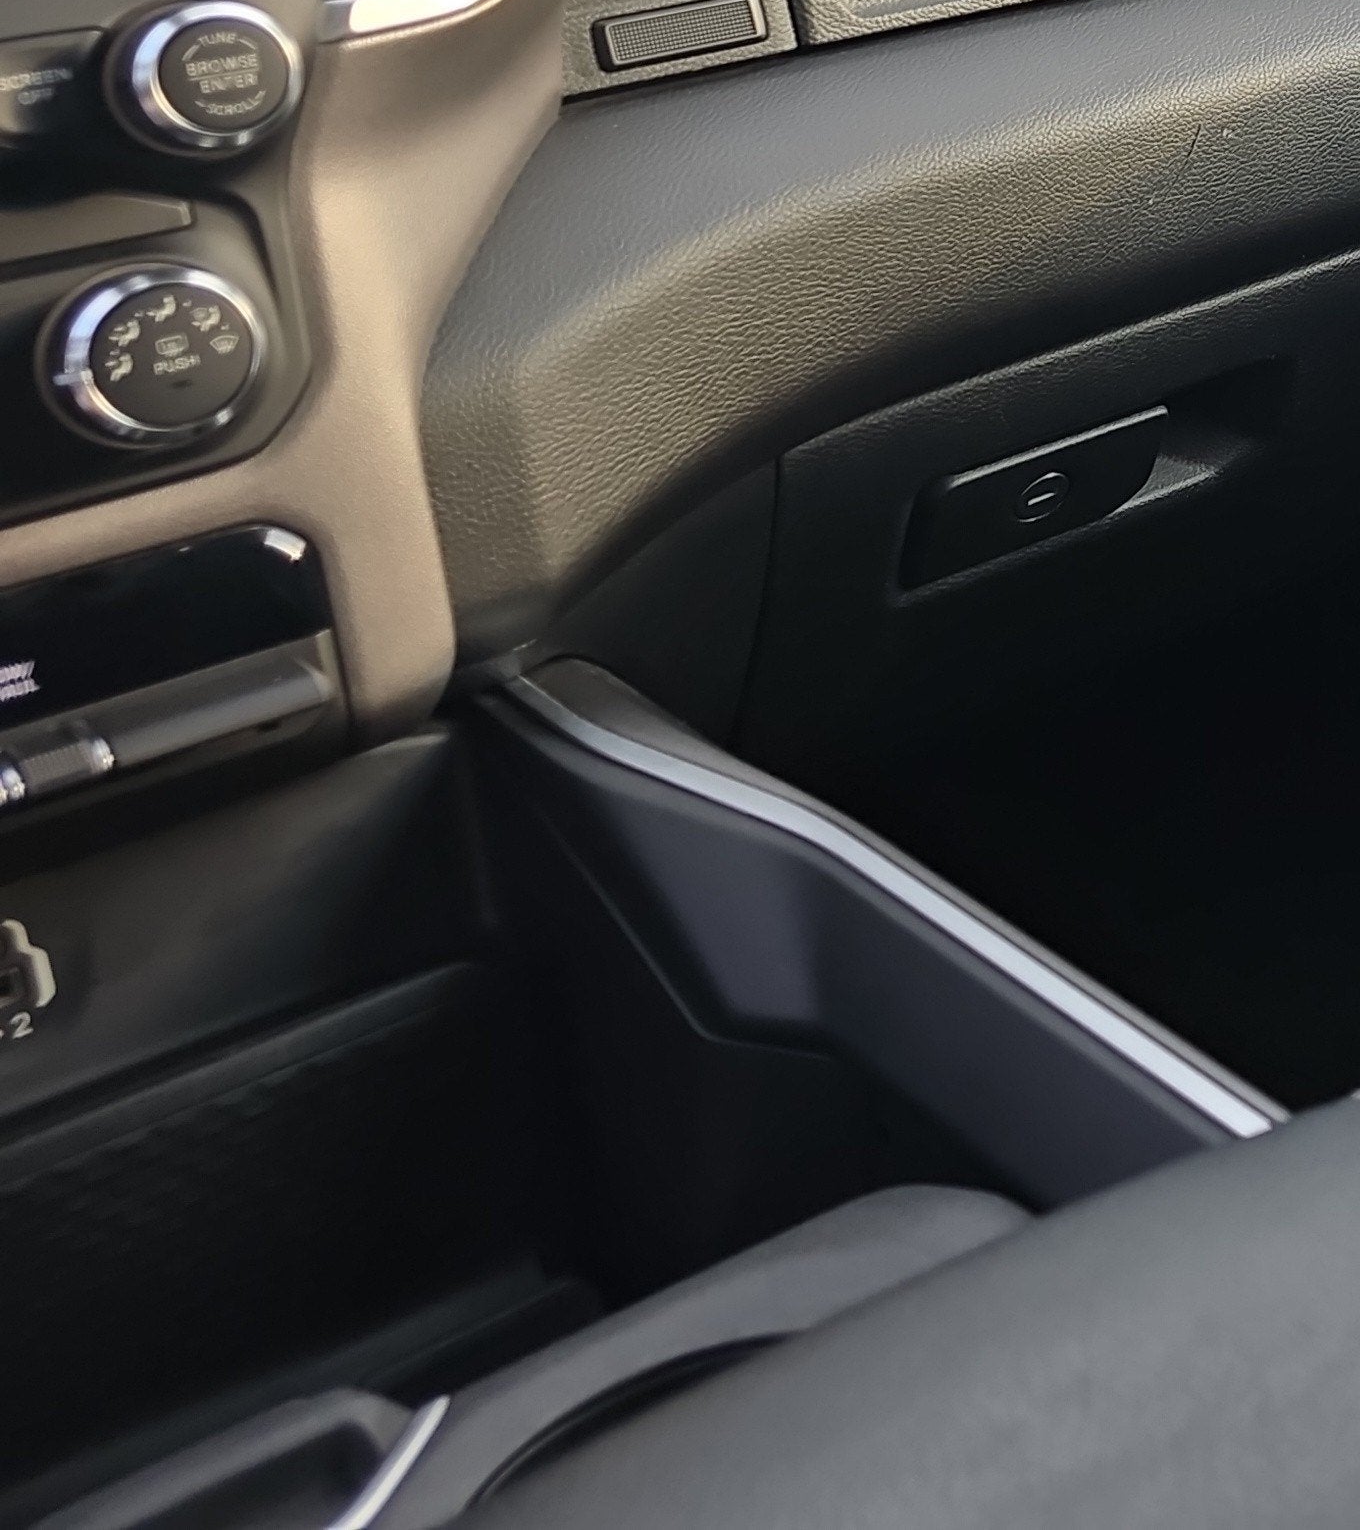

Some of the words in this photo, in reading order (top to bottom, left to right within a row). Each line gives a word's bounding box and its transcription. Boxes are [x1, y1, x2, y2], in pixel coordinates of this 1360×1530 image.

[198, 31, 237, 45] TUNE
[185, 53, 260, 77] BROWSE
[199, 74, 259, 94] ENTER
[205, 99, 259, 116] SCROLL
[153, 354, 201, 376] PUSH
